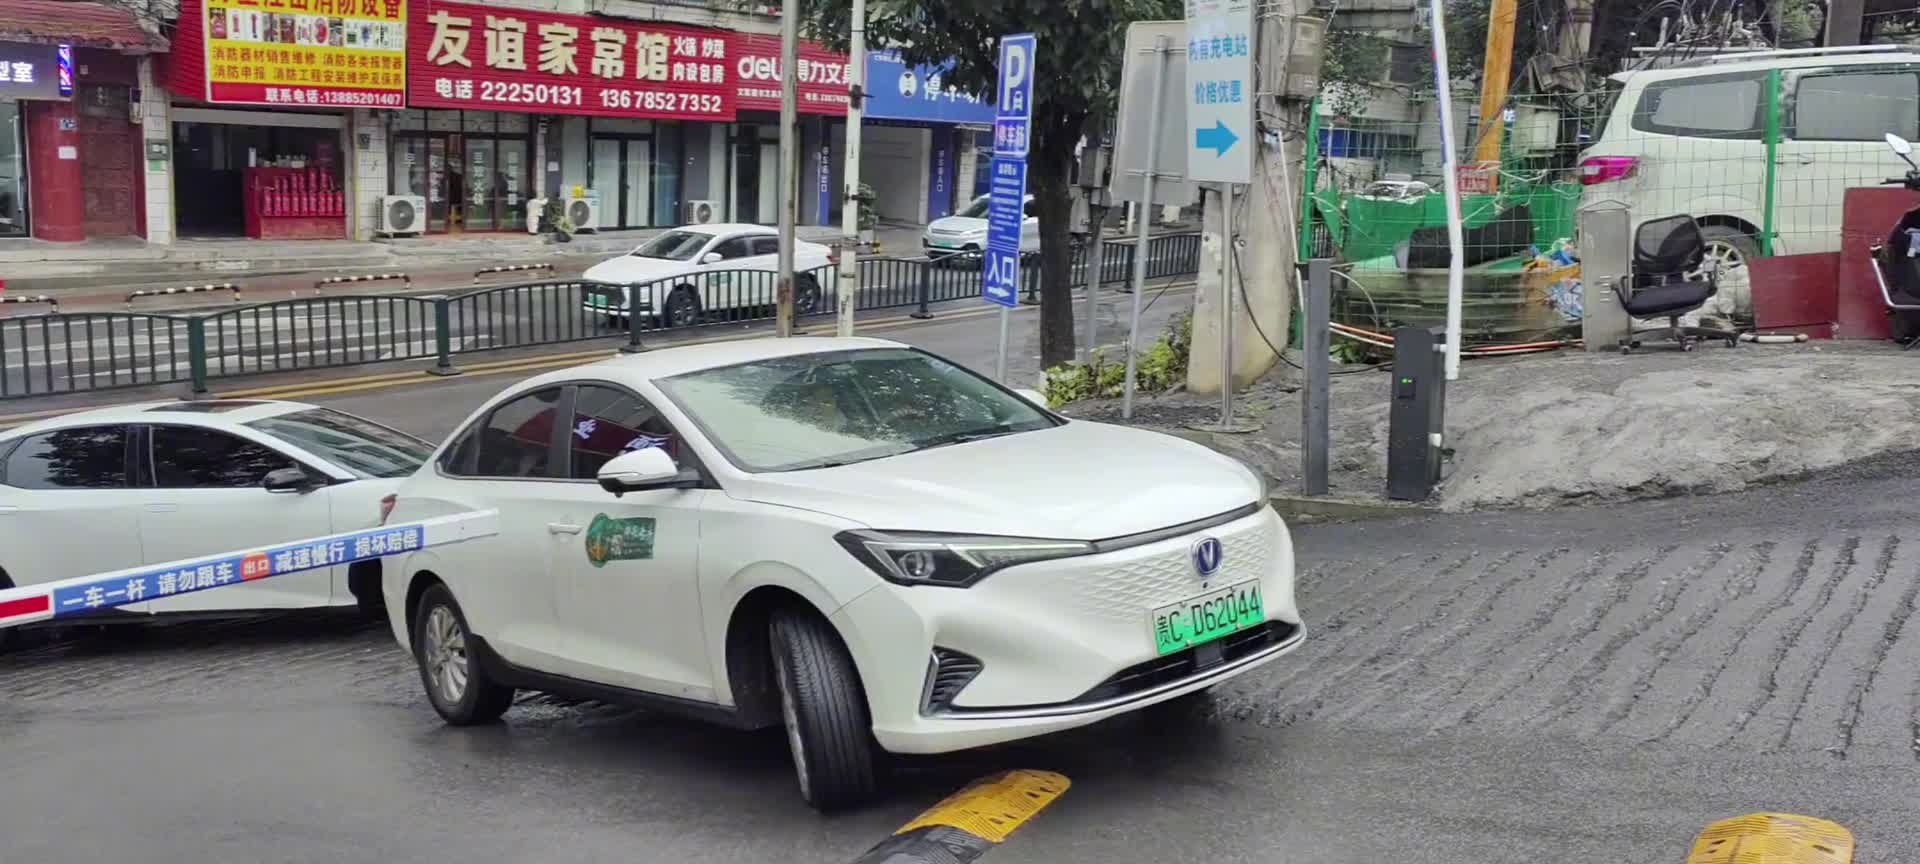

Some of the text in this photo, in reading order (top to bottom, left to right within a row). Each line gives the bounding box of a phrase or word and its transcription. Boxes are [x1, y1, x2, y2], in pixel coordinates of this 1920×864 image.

[427, 10, 671, 82] 友谊家常馆
[673, 36, 725, 59] 火锅 炒菜
[673, 61, 724, 84] 内设包房
[737, 55, 783, 81] del
[1003, 44, 1026, 112] P
[435, 78, 473, 99] 电话
[480, 81, 582, 106] 22250131
[599, 89, 722, 113] 13678527352
[1194, 80, 1242, 104] 价格优惠
[987, 251, 1015, 288] 入口
[244, 558, 271, 576] 出口
[275, 529, 418, 573] 减速慢行 损坏赔偿
[63, 562, 234, 608] 一车一杆 请勿跟车
